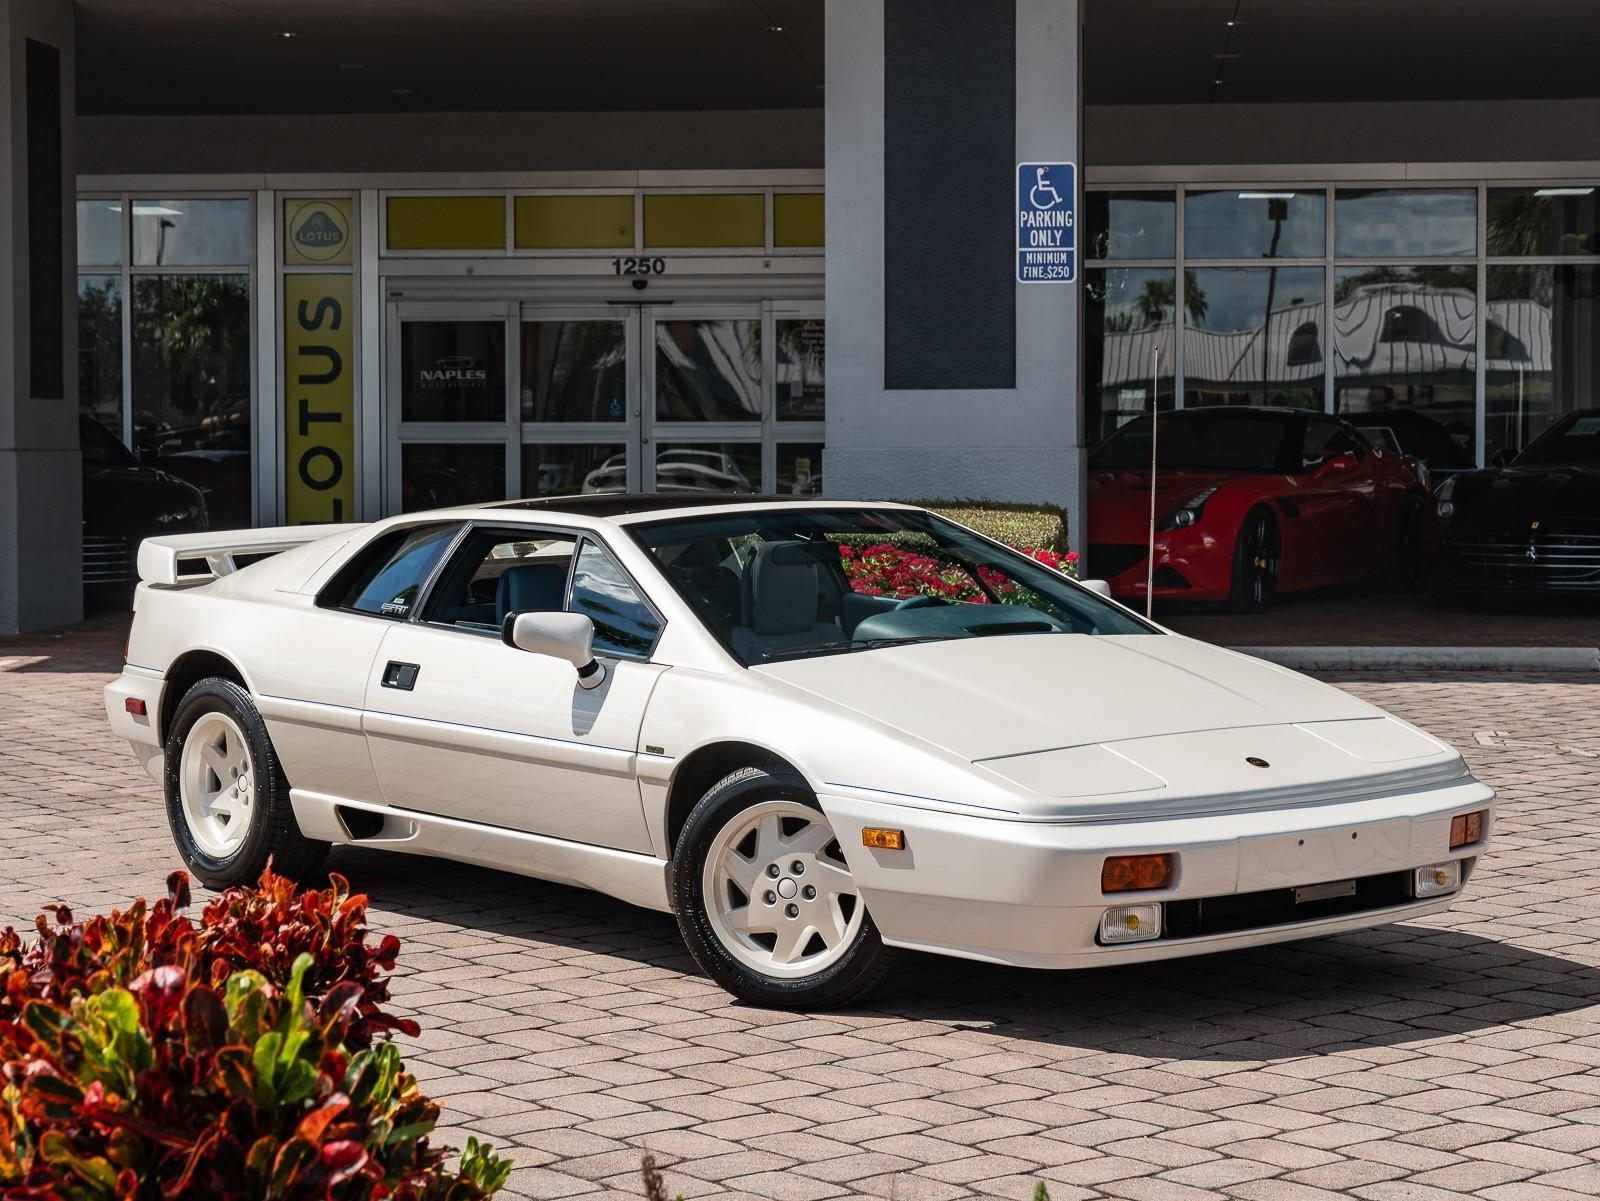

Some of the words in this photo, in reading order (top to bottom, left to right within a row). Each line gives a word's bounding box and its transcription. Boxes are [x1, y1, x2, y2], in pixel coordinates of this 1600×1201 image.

[1020, 211, 1073, 227] PARKING
[300, 231, 340, 241] LOTUS
[1030, 229, 1063, 246] ONLY
[1026, 252, 1067, 264] MINIMUM
[612, 257, 666, 275] 1250
[1023, 266, 1044, 278] FINE
[1047, 265, 1070, 279] $250
[420, 369, 487, 380] NAPLES
